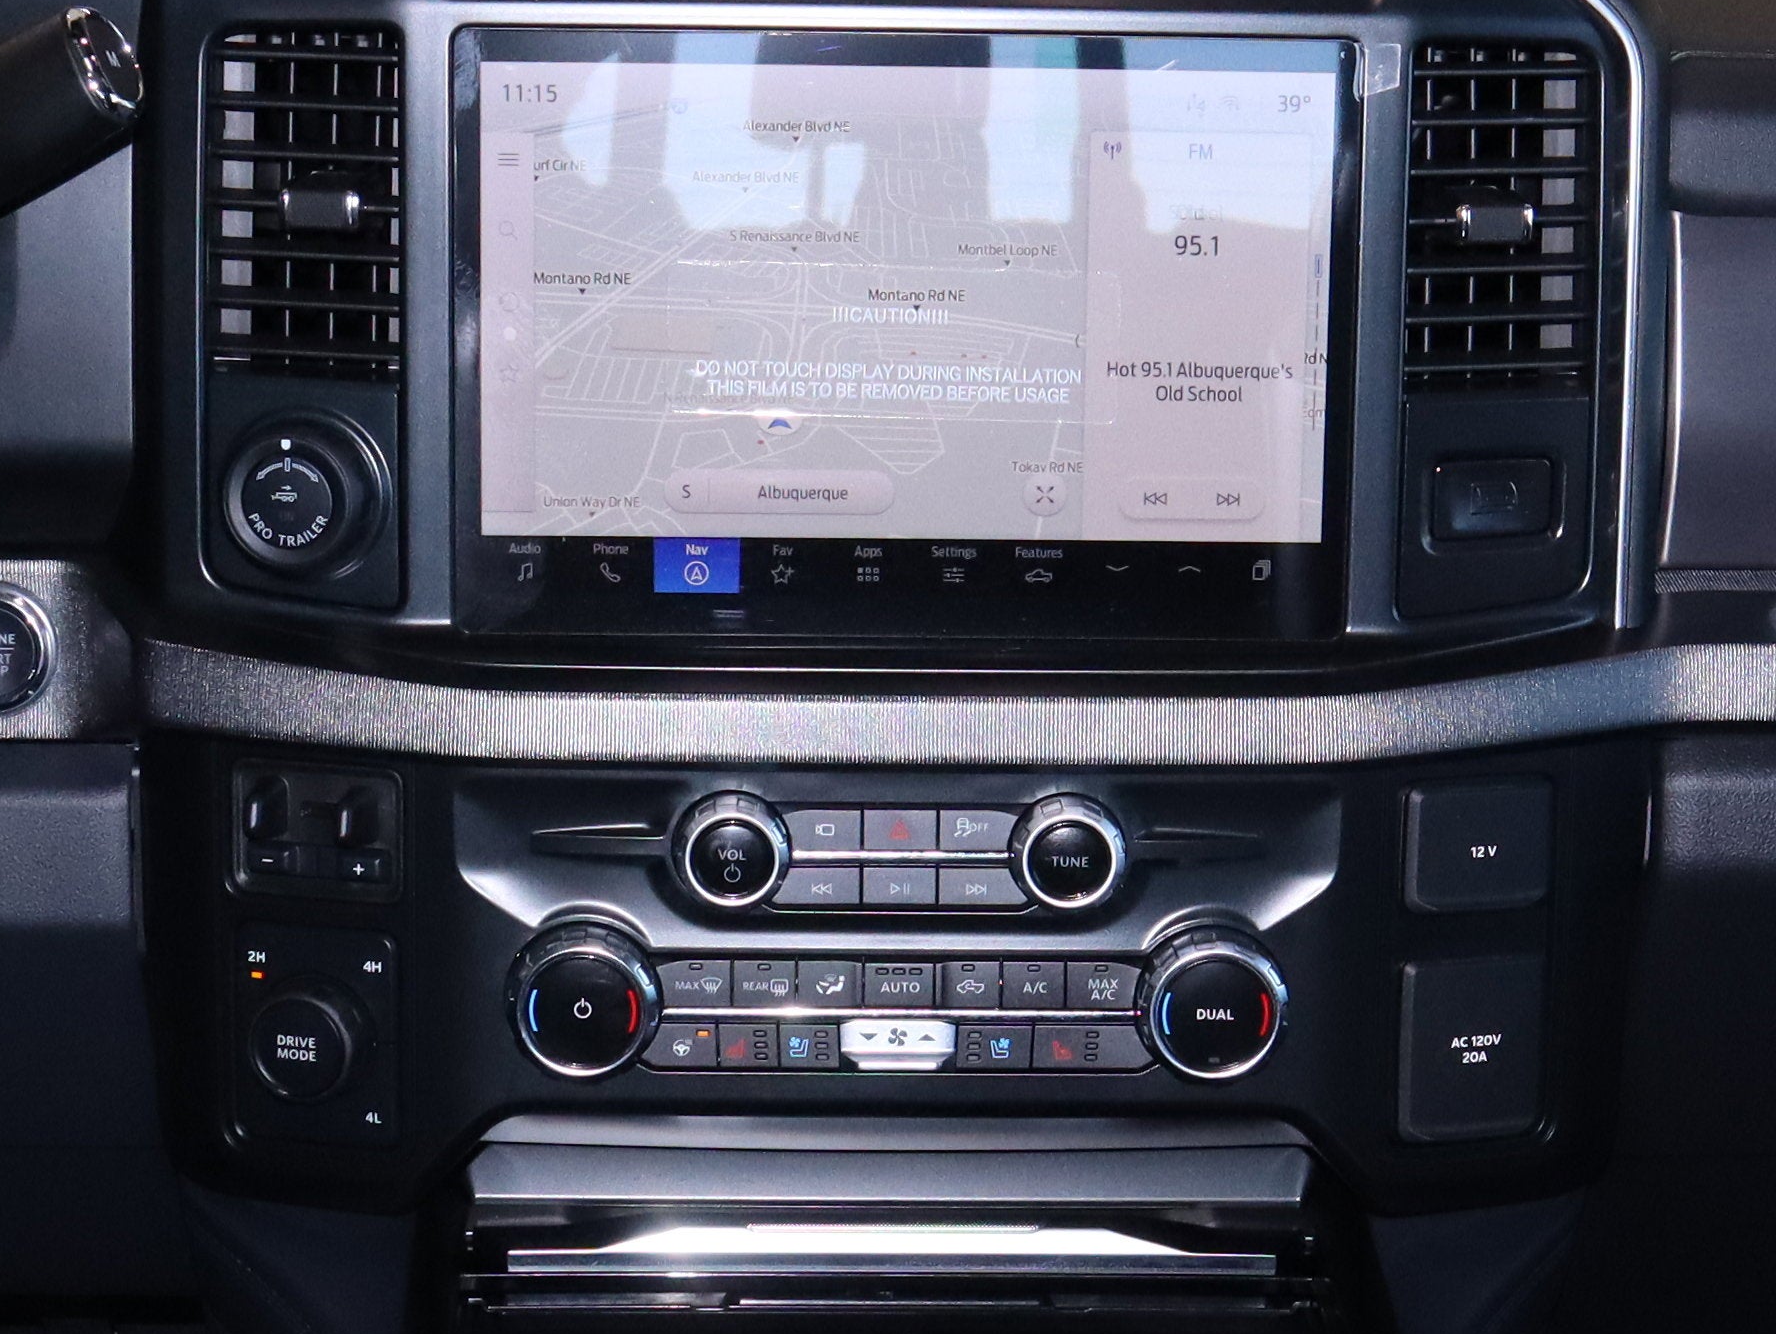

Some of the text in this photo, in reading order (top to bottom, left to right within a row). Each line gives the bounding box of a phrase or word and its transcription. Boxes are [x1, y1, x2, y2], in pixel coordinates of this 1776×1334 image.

[501, 83, 558, 104] 11:15
[743, 120, 851, 134] Alexander Blvd NE
[1188, 143, 1214, 160] FM
[692, 171, 800, 184] Alexander Blvd NE
[729, 229, 860, 243] S Renaissance Blvd NE
[957, 243, 1058, 258] Montbel Loop NE
[1173, 235, 1221, 258] 95.1
[533, 272, 632, 286] Montano Rd NE
[867, 289, 966, 303] Montano Rd NE
[695, 360, 1082, 385] DO NOT TOUCH DISPLAY DURING INSTALLATION
[1106, 361, 1294, 382] Hot 95.1 Albuquerque's
[707, 379, 1070, 405] THIS FILM IS TO BE REMOVED BEFORE USAGE
[1155, 385, 1243, 403] Old School
[1049, 462, 1065, 474] Rd
[1067, 462, 1084, 474] NE
[681, 484, 691, 499] S
[757, 485, 849, 502] Albuquerque
[543, 496, 640, 510] Union Way Dr NE
[248, 512, 329, 547] PRO TRAILER
[508, 543, 542, 555] Audio
[593, 543, 629, 555] Phone
[685, 544, 709, 556] Nav
[773, 544, 794, 557] Fav
[854, 545, 883, 559] Apps
[931, 545, 977, 560] Settings
[1014, 546, 1063, 559] Features
[969, 823, 990, 834] OFF
[717, 849, 747, 861] VOL
[1470, 845, 1498, 858] 12 V
[1051, 856, 1090, 868] TUNE
[247, 950, 266, 963] 2H
[362, 960, 382, 973] 4H
[675, 981, 700, 990] MAX
[742, 981, 769, 991] REAR
[880, 981, 921, 993] AUTO
[1023, 981, 1048, 994] A/C
[1087, 978, 1119, 990] MAX
[1090, 989, 1116, 1001] A/C
[1196, 1008, 1234, 1021] DUAL
[276, 1034, 317, 1049] DRIVE
[1450, 1033, 1502, 1049] AC 120V
[276, 1048, 317, 1062] MODE
[1461, 1050, 1488, 1064] 20A
[365, 1111, 382, 1124] 4L
